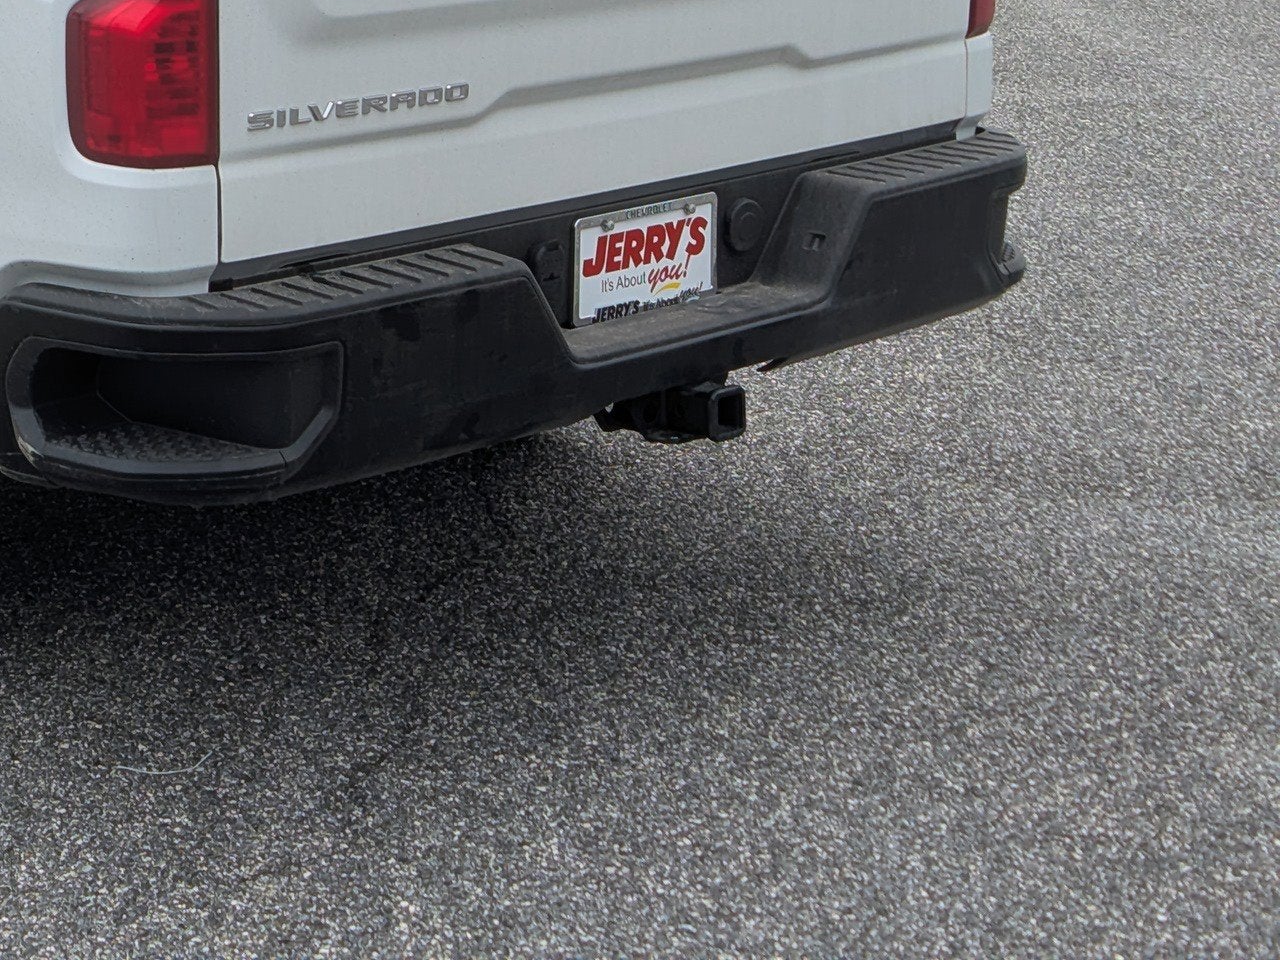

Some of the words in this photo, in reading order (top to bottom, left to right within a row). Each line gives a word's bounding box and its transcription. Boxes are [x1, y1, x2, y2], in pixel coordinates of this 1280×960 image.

[247, 83, 470, 132] SILVERADO
[625, 203, 673, 220] CHEVROLET
[582, 216, 708, 278] JERRY'S
[601, 278, 614, 293] It's
[616, 273, 646, 291] About
[648, 254, 691, 293] you!
[592, 300, 641, 324] JERRY'S
